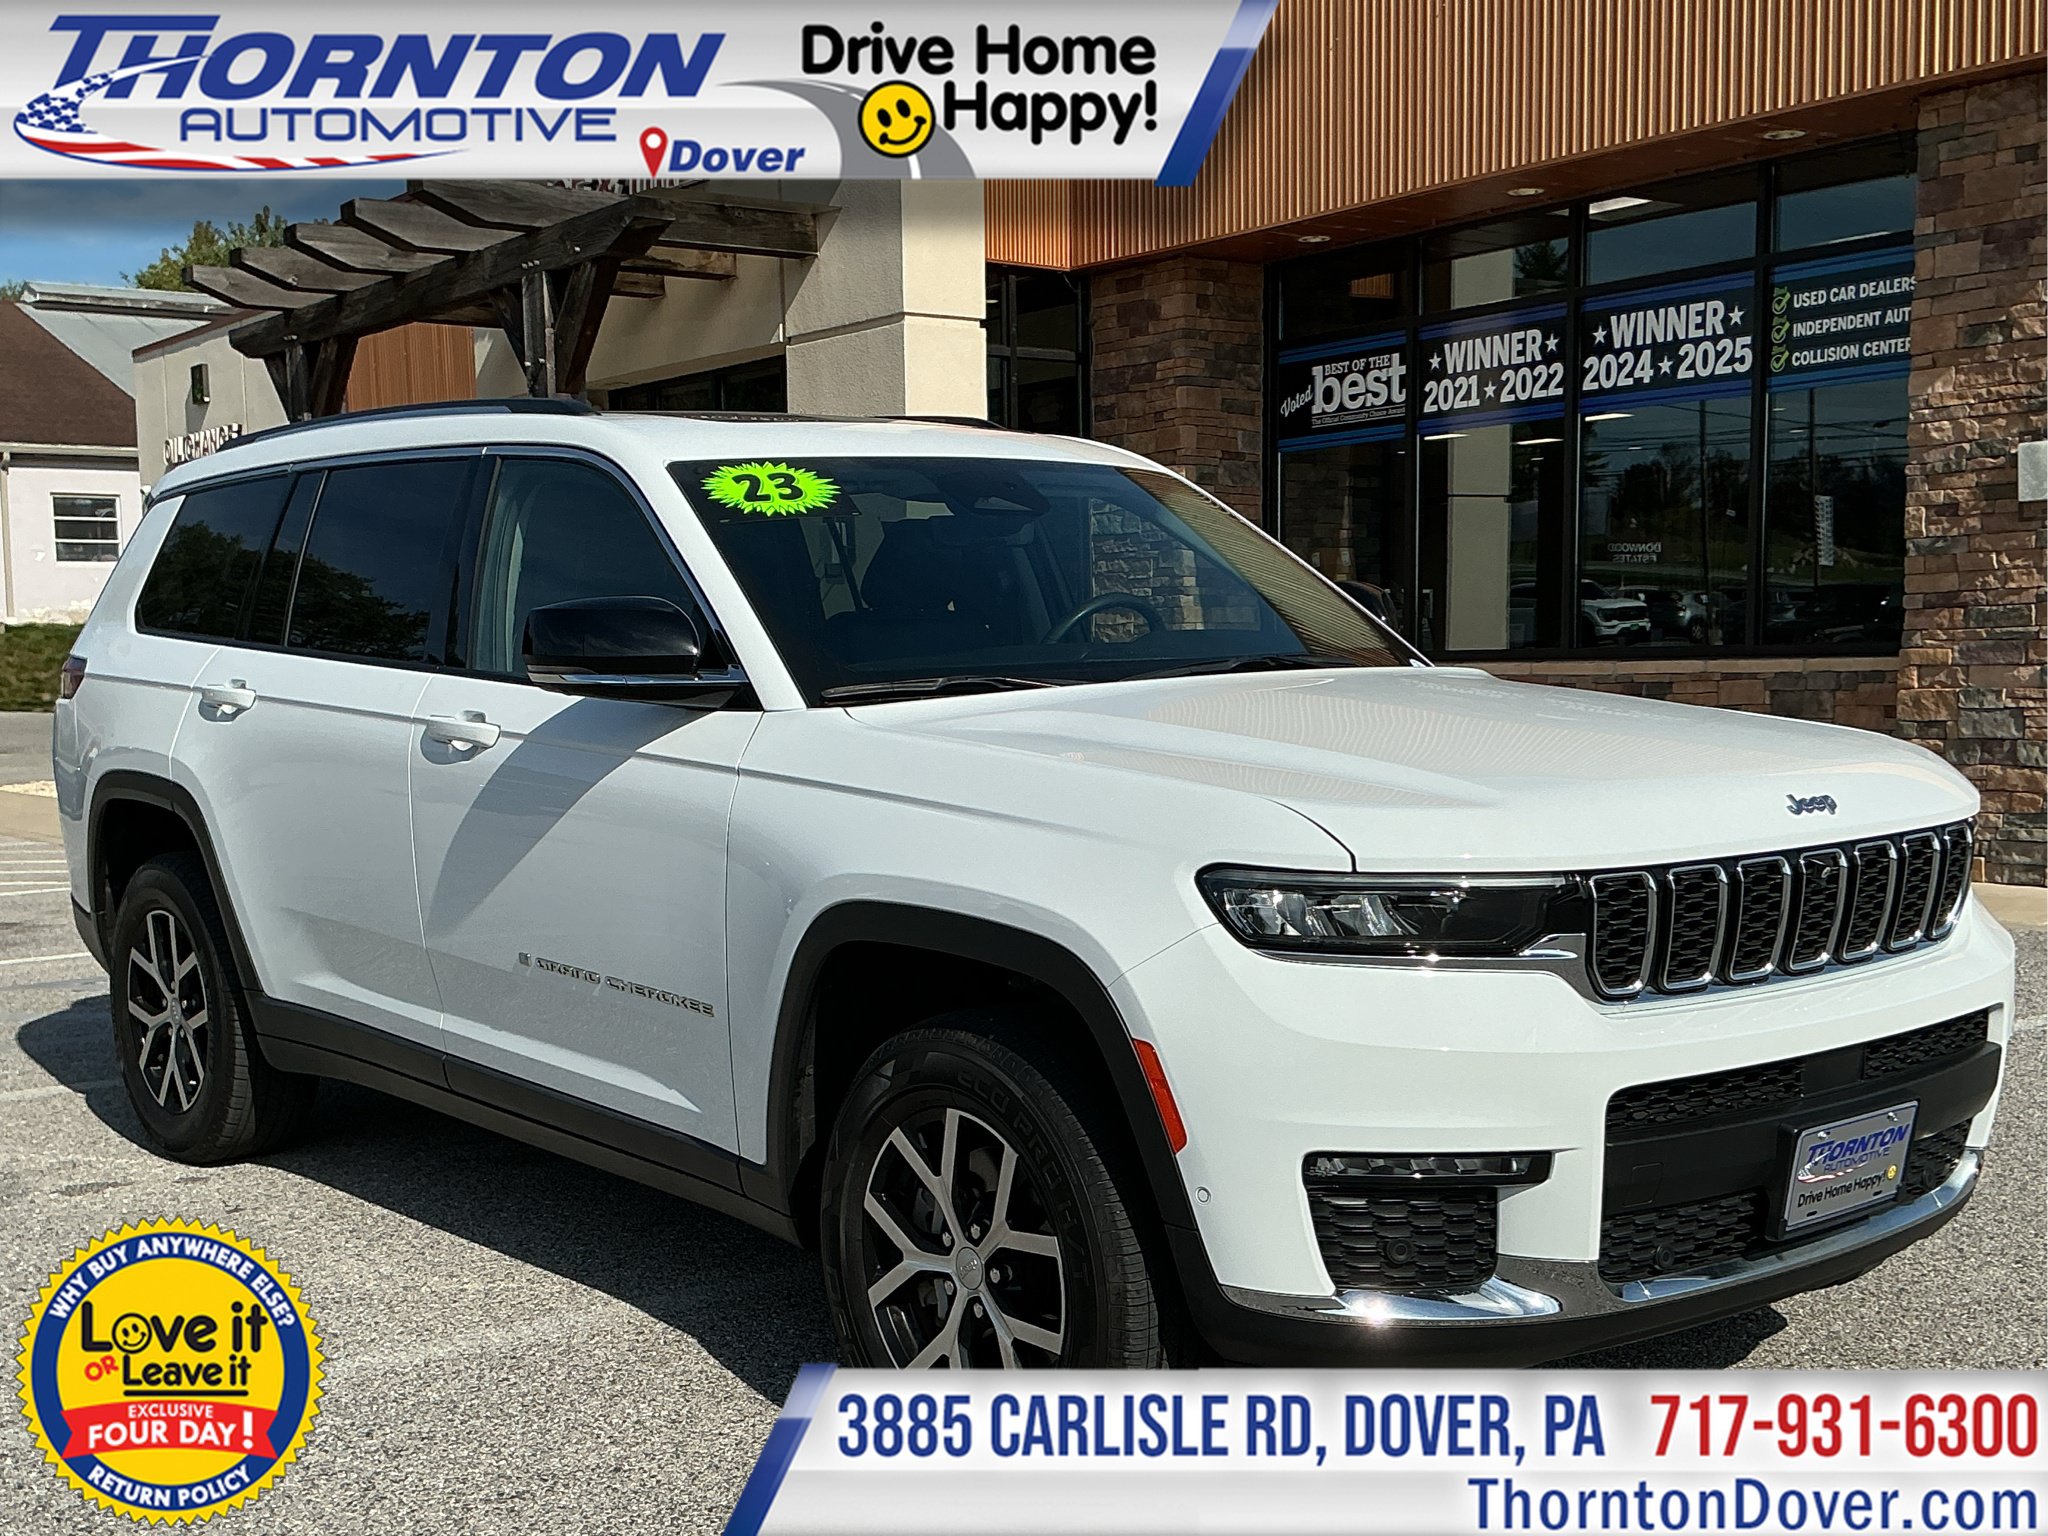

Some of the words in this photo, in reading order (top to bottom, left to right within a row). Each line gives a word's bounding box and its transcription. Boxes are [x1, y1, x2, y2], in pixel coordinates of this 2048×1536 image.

[1793, 290, 1826, 308] USED
[1830, 284, 1856, 302] CAR
[1610, 300, 1725, 349] WINNER
[1792, 311, 1882, 337] INDEPENDENT
[1324, 361, 1350, 376] BEST
[1351, 359, 1367, 371] OF
[1369, 354, 1390, 368] THE
[1444, 329, 1543, 374] WINNER
[1582, 349, 1654, 391] 2024
[1677, 335, 1753, 379] 2025
[1791, 343, 1859, 366] COLLISION
[1311, 352, 1407, 414] best
[1423, 374, 1480, 413] 2021
[1500, 362, 1564, 403] 2022
[1280, 384, 1314, 418] Voted
[163, 436, 185, 466] OIL
[731, 472, 804, 502] 23
[1785, 794, 1837, 815] Jeep
[535, 957, 600, 984] GRAND
[604, 975, 715, 1018] CHEROKEE
[1807, 1124, 1910, 1165] THORNTON
[1824, 1146, 1891, 1171] AUTOMOTIVE
[1797, 1191, 1823, 1207] Drive
[1824, 1182, 1852, 1200] Home
[1853, 1169, 1887, 1191] Happy!
